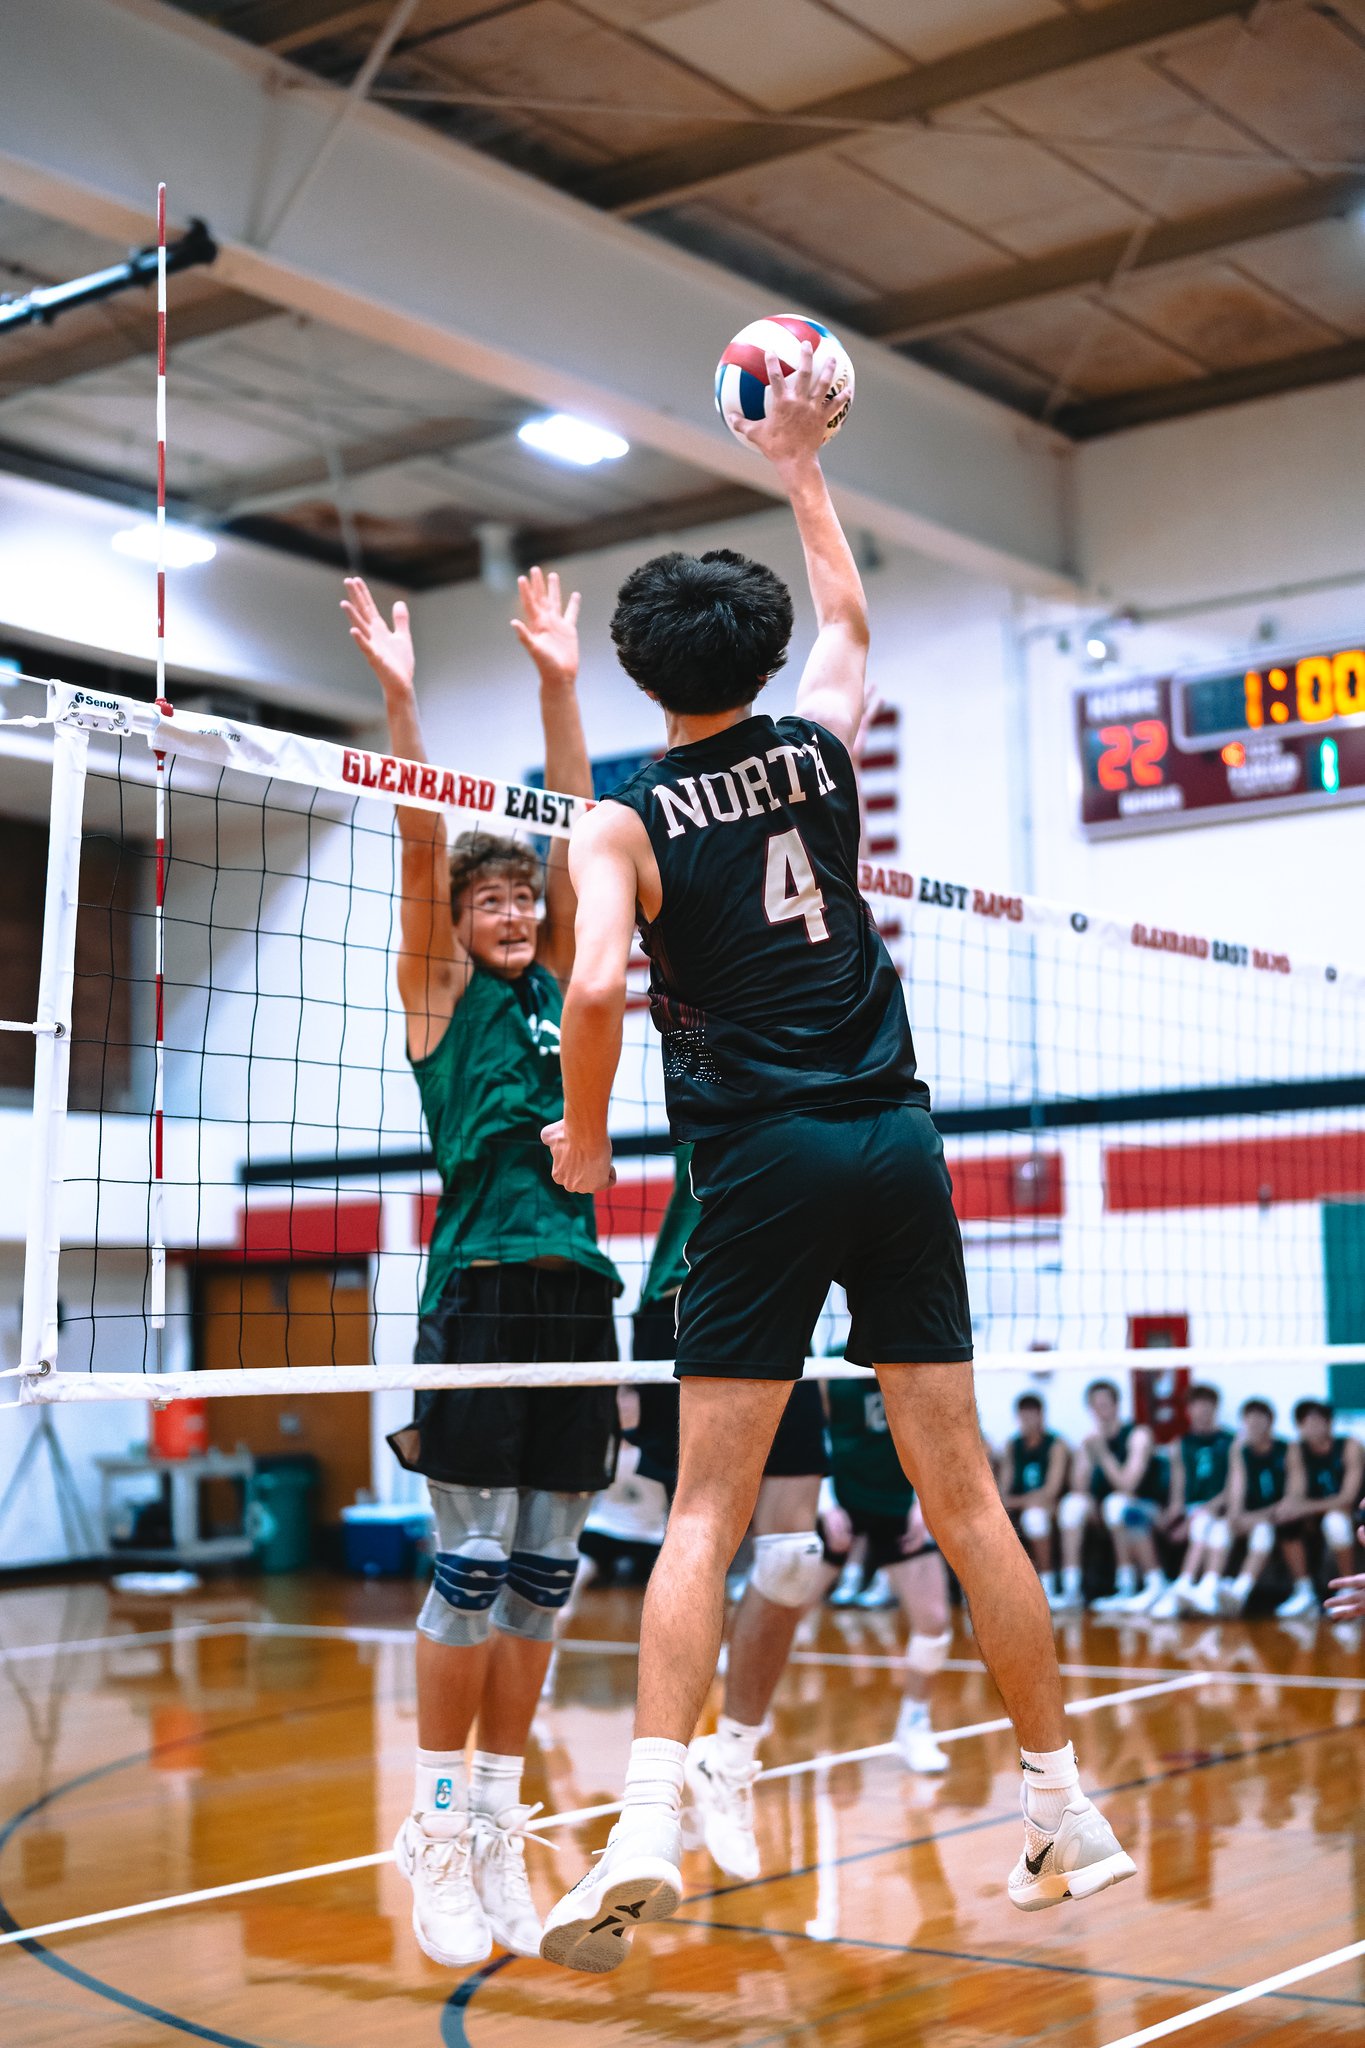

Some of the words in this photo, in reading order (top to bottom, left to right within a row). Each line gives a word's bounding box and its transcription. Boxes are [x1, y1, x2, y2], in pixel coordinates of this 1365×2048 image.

[85, 695, 119, 711] Senoh
[1245, 650, 1365, 730] 1:00
[342, 749, 496, 812] GLENBARD
[504, 786, 575, 828] EAST
[652, 734, 837, 839] NORTH
[1098, 720, 1168, 791] 22
[1320, 737, 1339, 794] 1
[763, 826, 829, 943] 4
[918, 876, 969, 911] EAST
